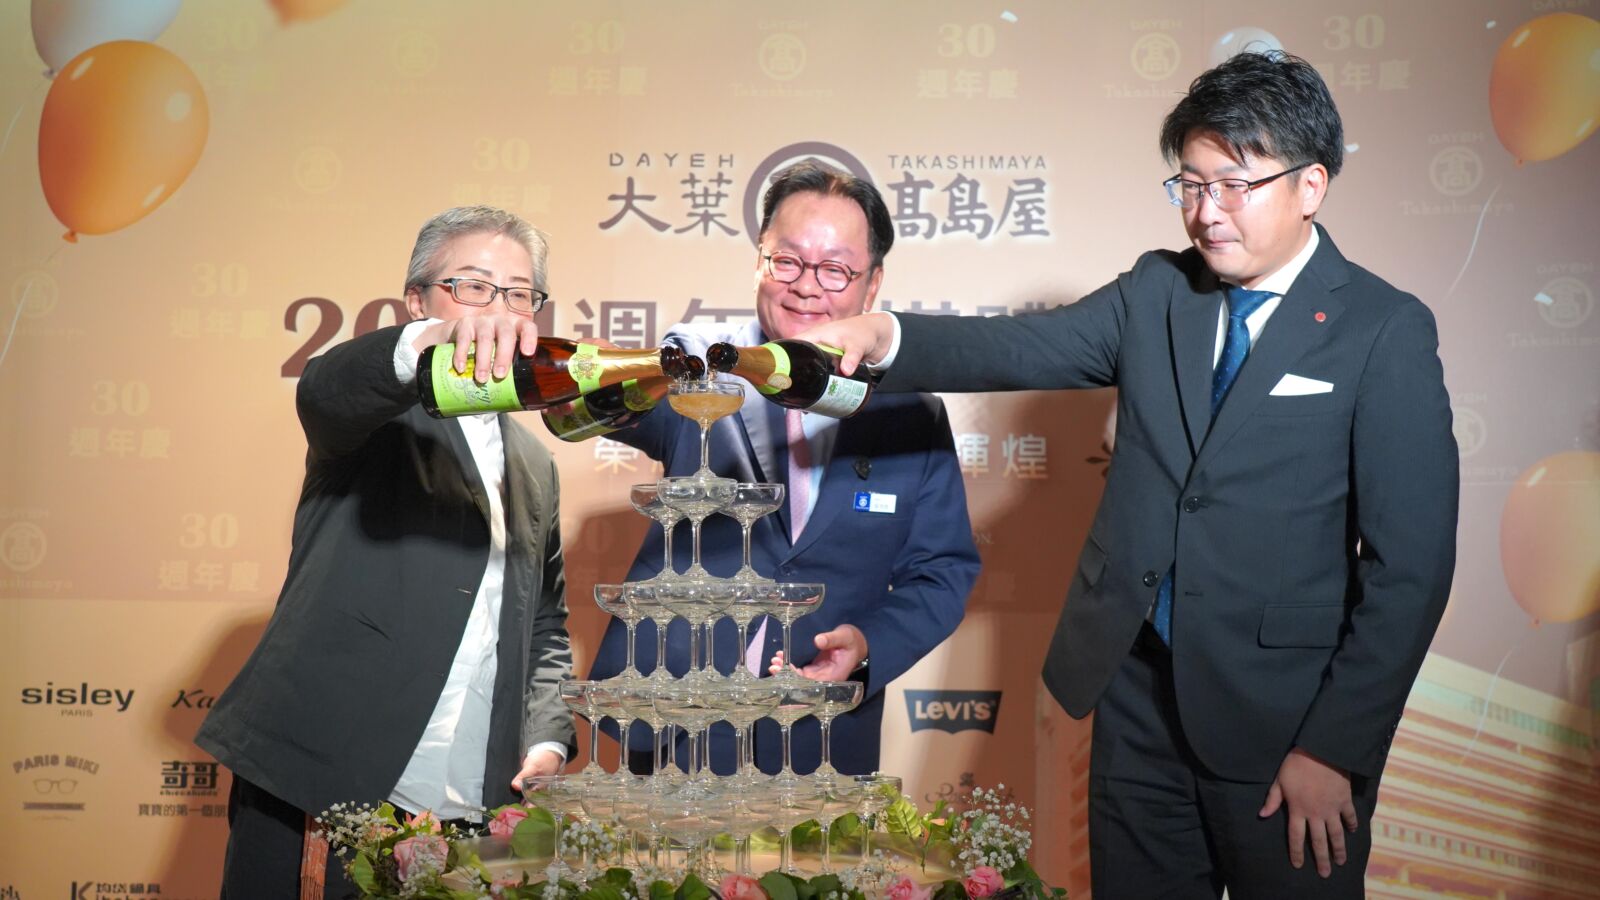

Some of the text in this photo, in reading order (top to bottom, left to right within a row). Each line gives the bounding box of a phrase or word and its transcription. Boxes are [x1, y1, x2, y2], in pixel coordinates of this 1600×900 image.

[568, 20, 625, 55] 30
[937, 23, 995, 58] 30
[1323, 14, 1385, 50] 30
[916, 68, 1020, 100] 週年慶
[471, 137, 531, 173] 30
[608, 152, 734, 168] DAYEH
[888, 155, 1047, 170] TAKASHIMAYA
[598, 172, 741, 236] 大葉
[191, 262, 249, 298] 30
[90, 379, 151, 416] 30
[179, 512, 240, 550] 30
[157, 560, 260, 592] 週年慶
[22, 682, 134, 712] sisley
[61, 709, 93, 718] PARIS
[13, 754, 100, 775] PARIS MIKI
